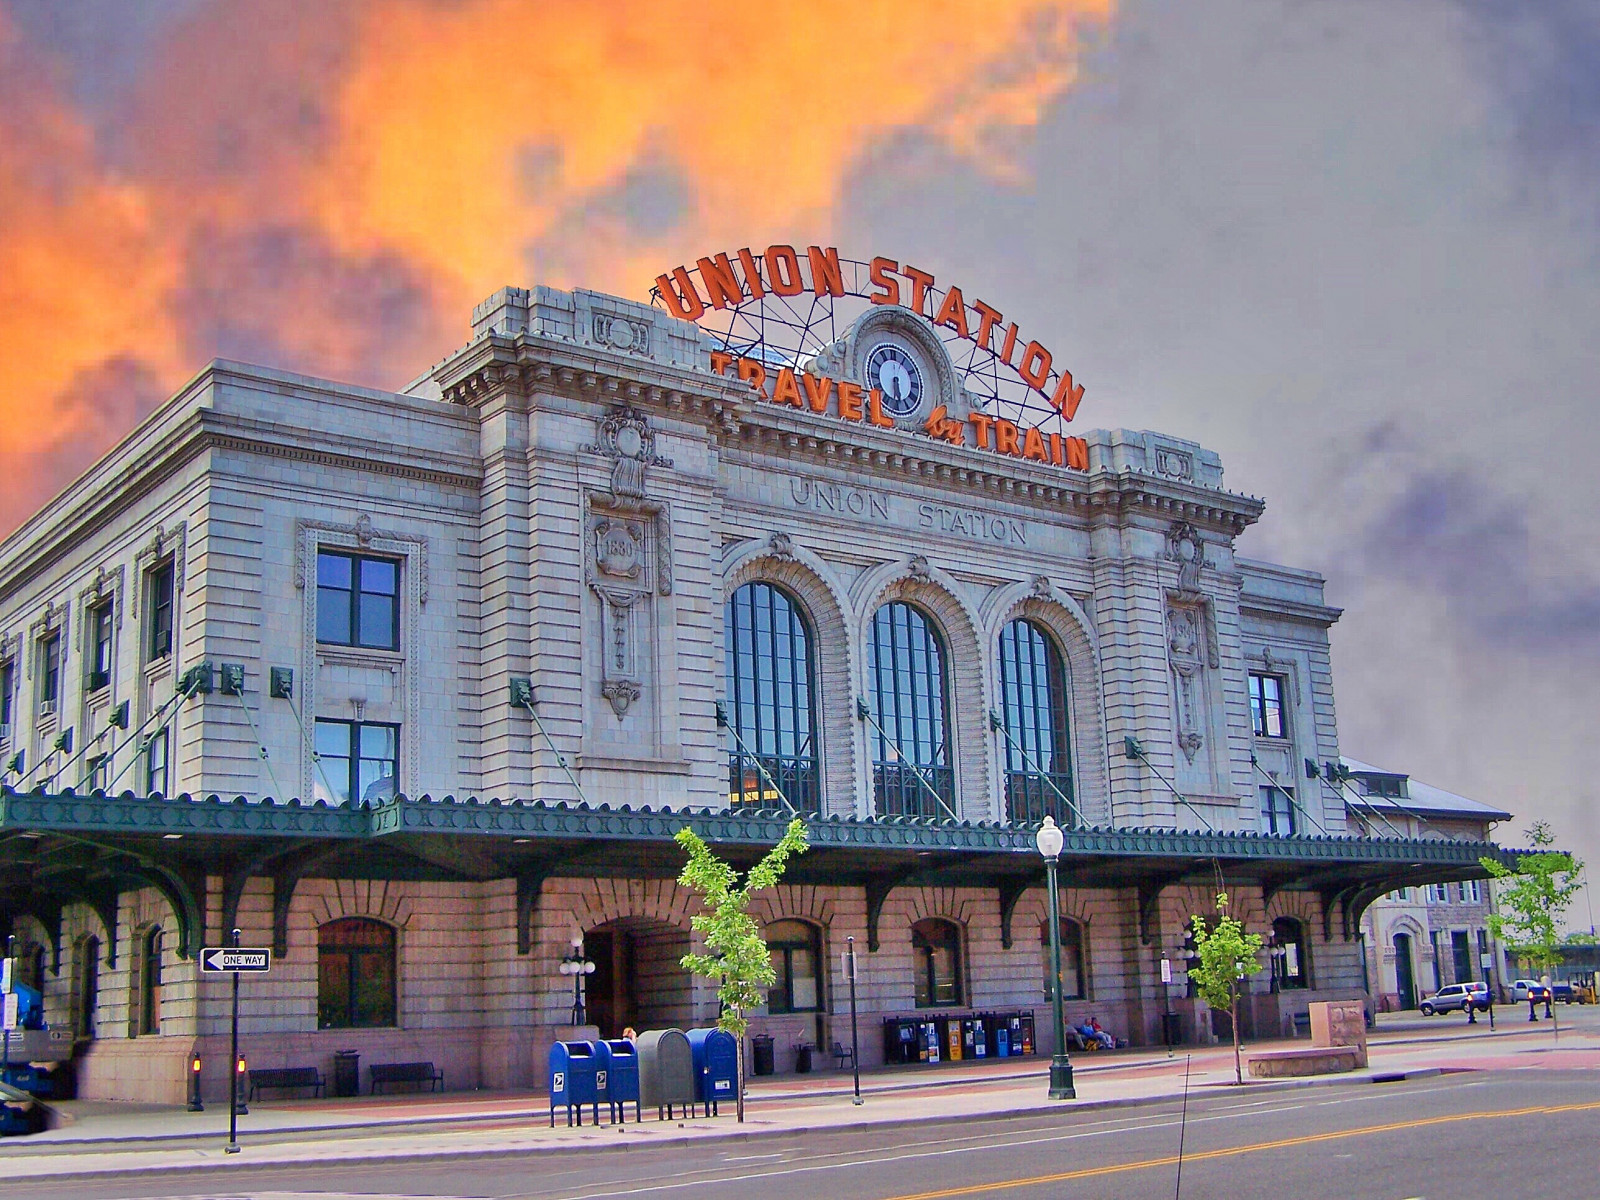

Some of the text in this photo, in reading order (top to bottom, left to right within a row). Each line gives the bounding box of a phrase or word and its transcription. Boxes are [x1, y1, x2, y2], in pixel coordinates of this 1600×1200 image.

[655, 245, 1085, 422] UNION STATION
[710, 351, 1089, 471] TRAVEL by TRAIN
[789, 478, 1027, 545] UNION STATION
[223, 955, 263, 965] ONE WAY
